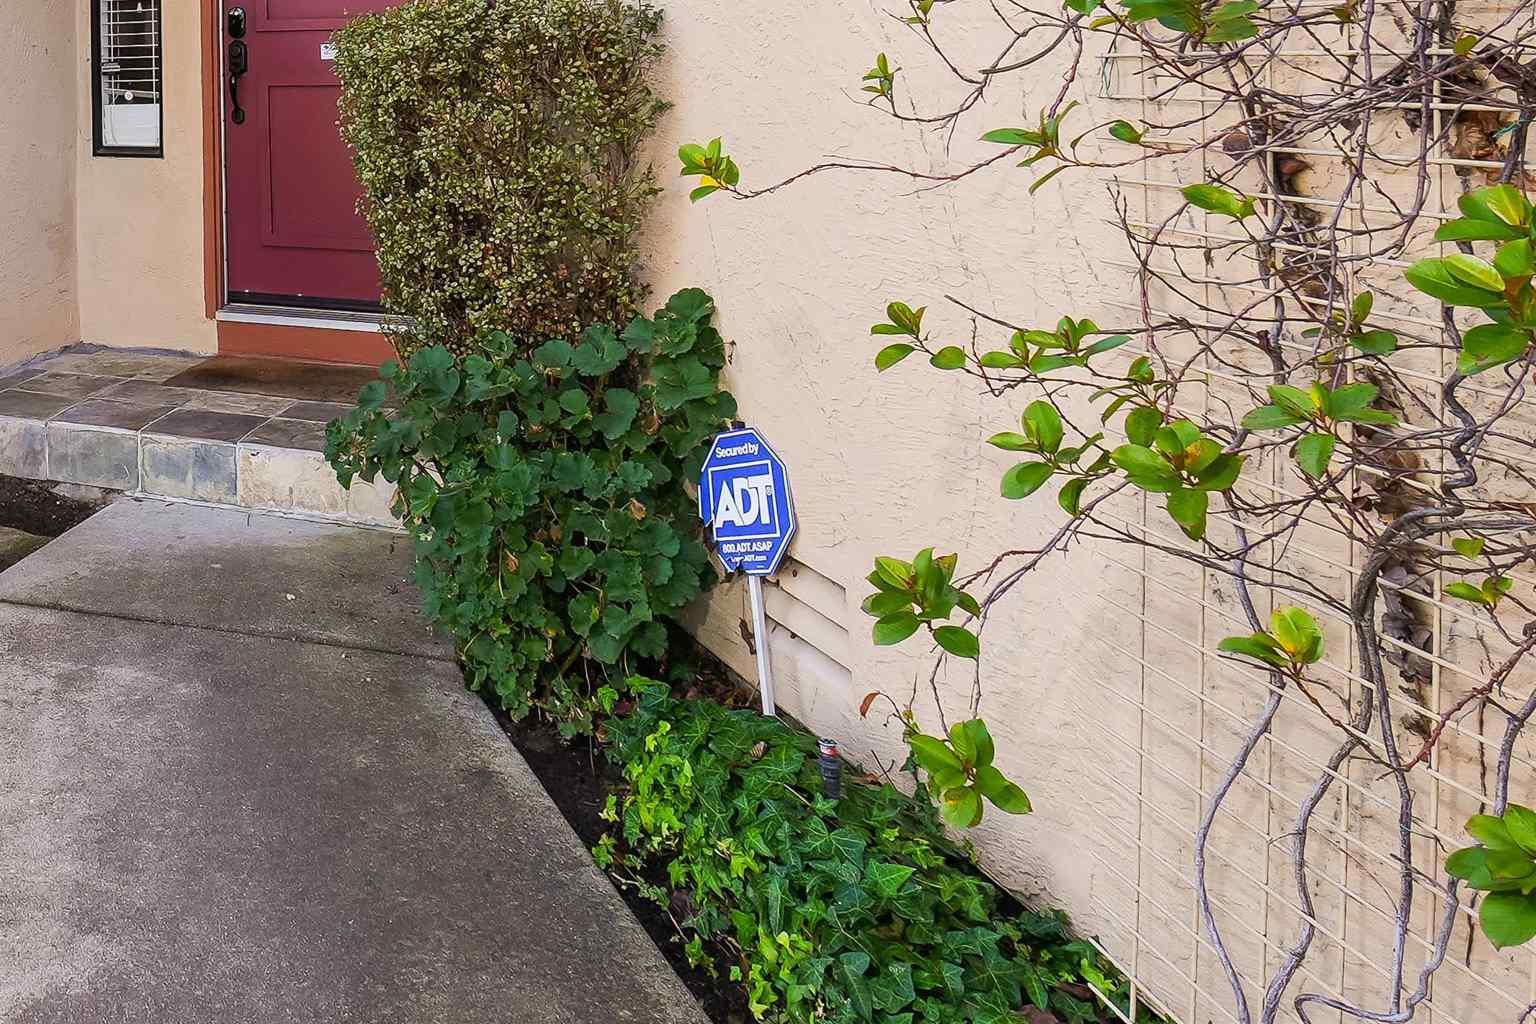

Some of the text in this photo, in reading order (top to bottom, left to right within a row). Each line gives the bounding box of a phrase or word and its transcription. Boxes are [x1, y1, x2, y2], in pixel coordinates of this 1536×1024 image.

[715, 442, 759, 458] Secured by
[714, 475, 772, 528] ADT
